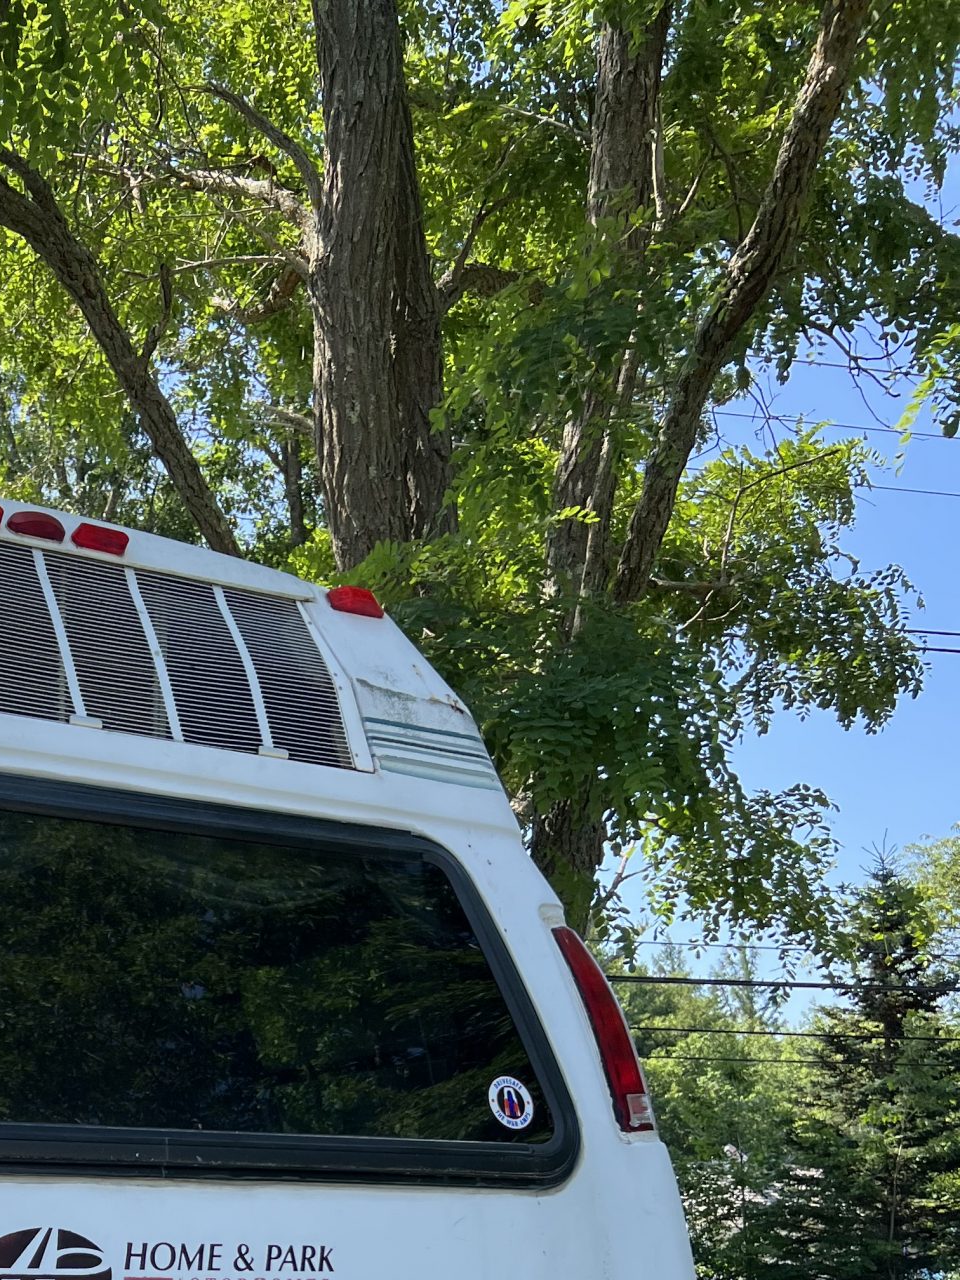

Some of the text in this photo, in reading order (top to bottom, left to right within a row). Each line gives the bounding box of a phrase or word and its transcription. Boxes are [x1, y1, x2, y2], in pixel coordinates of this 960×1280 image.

[495, 1110, 505, 1121] THE
[506, 1119, 519, 1127] WAR
[124, 1241, 335, 1272] HOME & PARK
